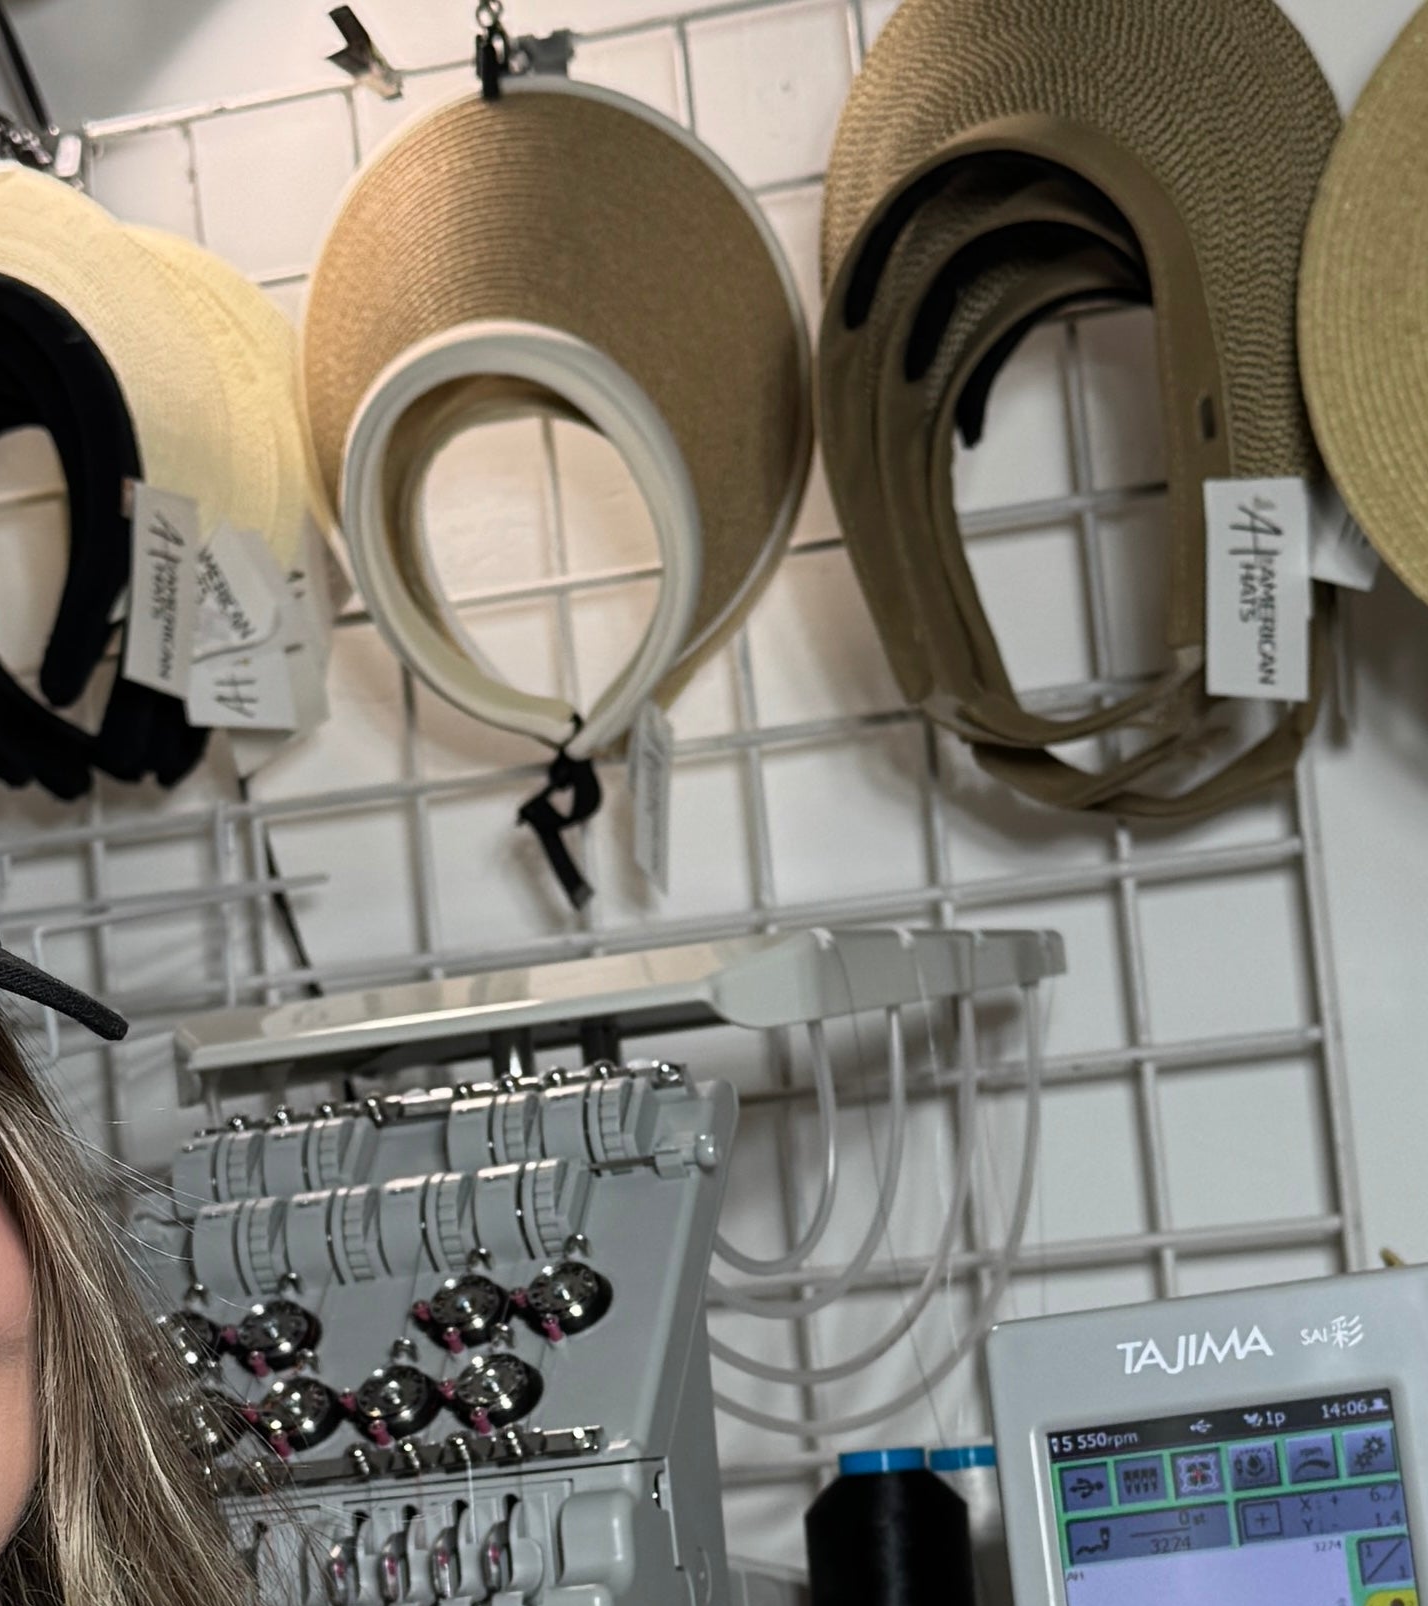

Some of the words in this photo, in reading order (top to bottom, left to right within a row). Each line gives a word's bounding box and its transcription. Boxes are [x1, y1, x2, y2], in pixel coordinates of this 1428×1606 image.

[1237, 561, 1257, 623] HATS
[1257, 566, 1278, 686] AMERICAN
[1116, 1325, 1274, 1375] TAJIMA
[1321, 1399, 1368, 1419] 14:06
[1077, 1431, 1139, 1451] 550rpm
